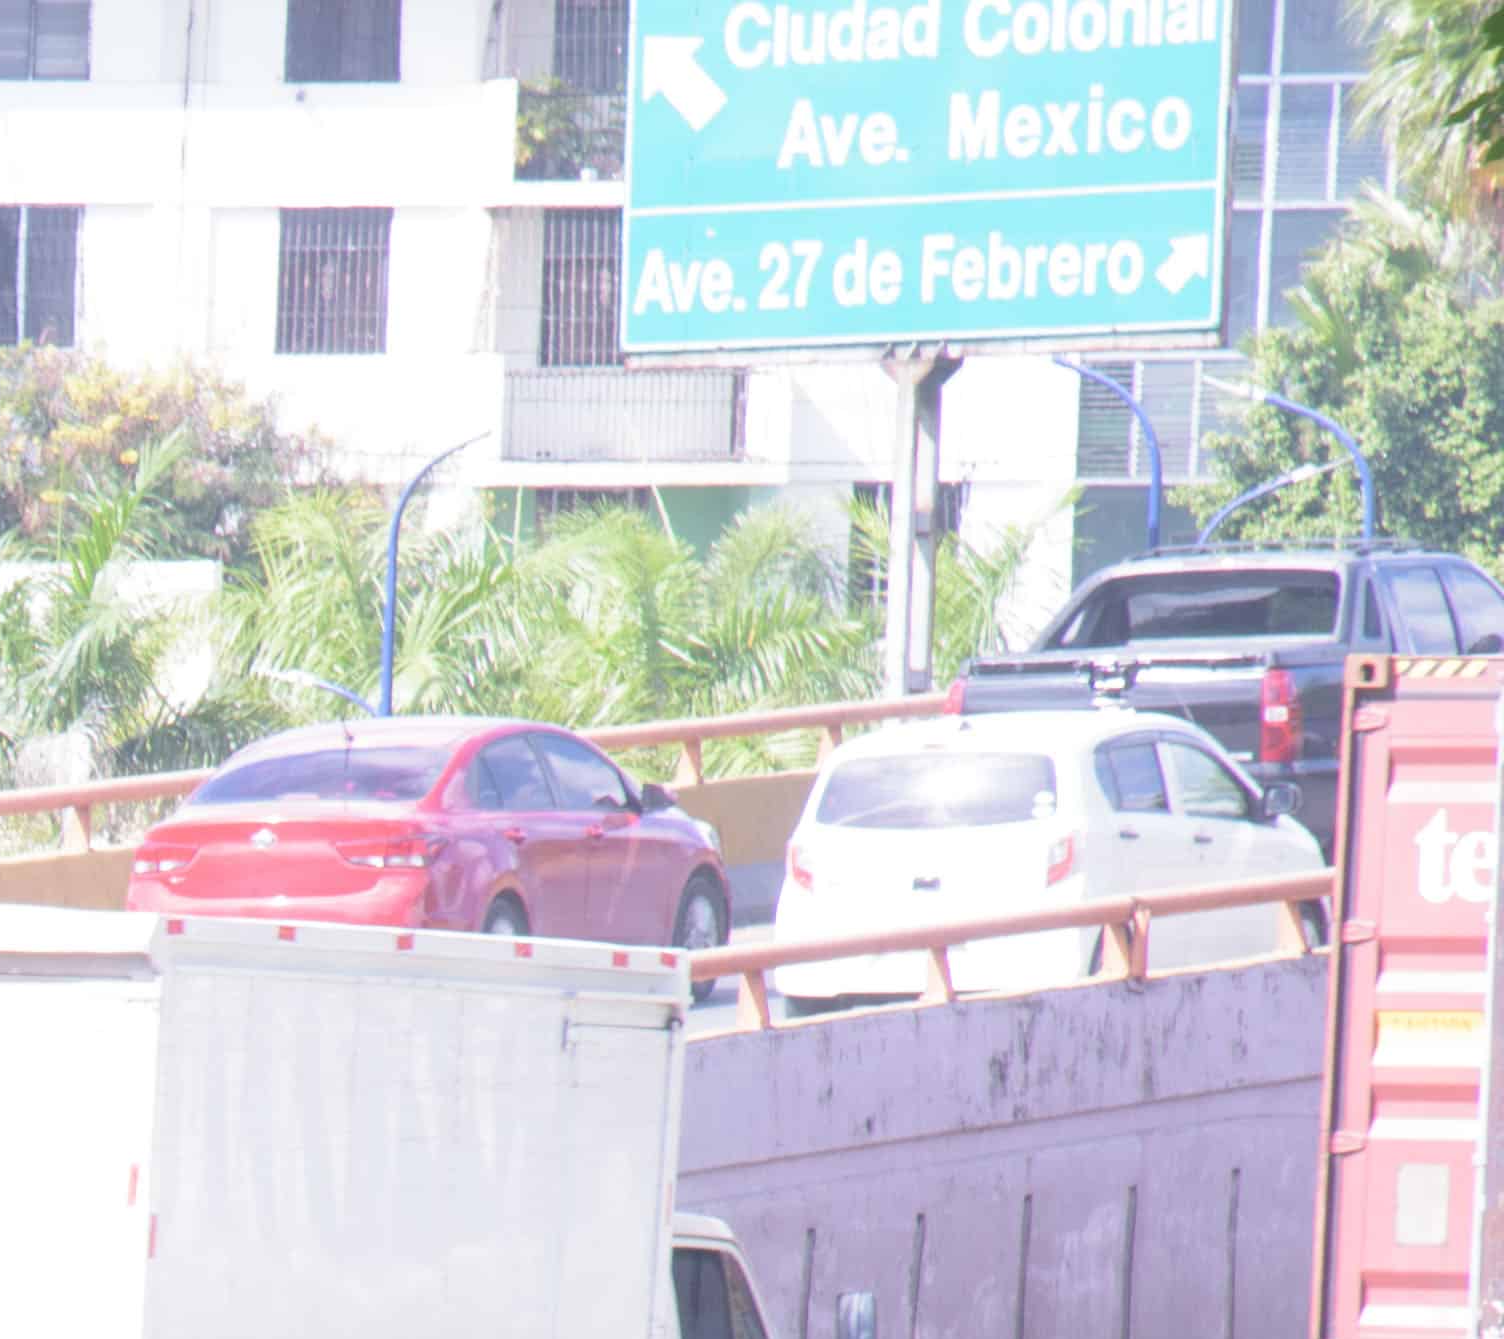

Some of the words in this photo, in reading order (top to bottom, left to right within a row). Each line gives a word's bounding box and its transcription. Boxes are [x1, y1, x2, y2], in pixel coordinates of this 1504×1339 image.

[724, 0, 939, 68] Ciudad
[963, 0, 1216, 57] Colonial
[777, 98, 909, 170] Ave.
[947, 85, 1192, 162] Mexico
[634, 248, 746, 315] Ave.
[759, 240, 823, 310] 27
[833, 238, 902, 306] de
[920, 232, 1145, 304] Febrero
